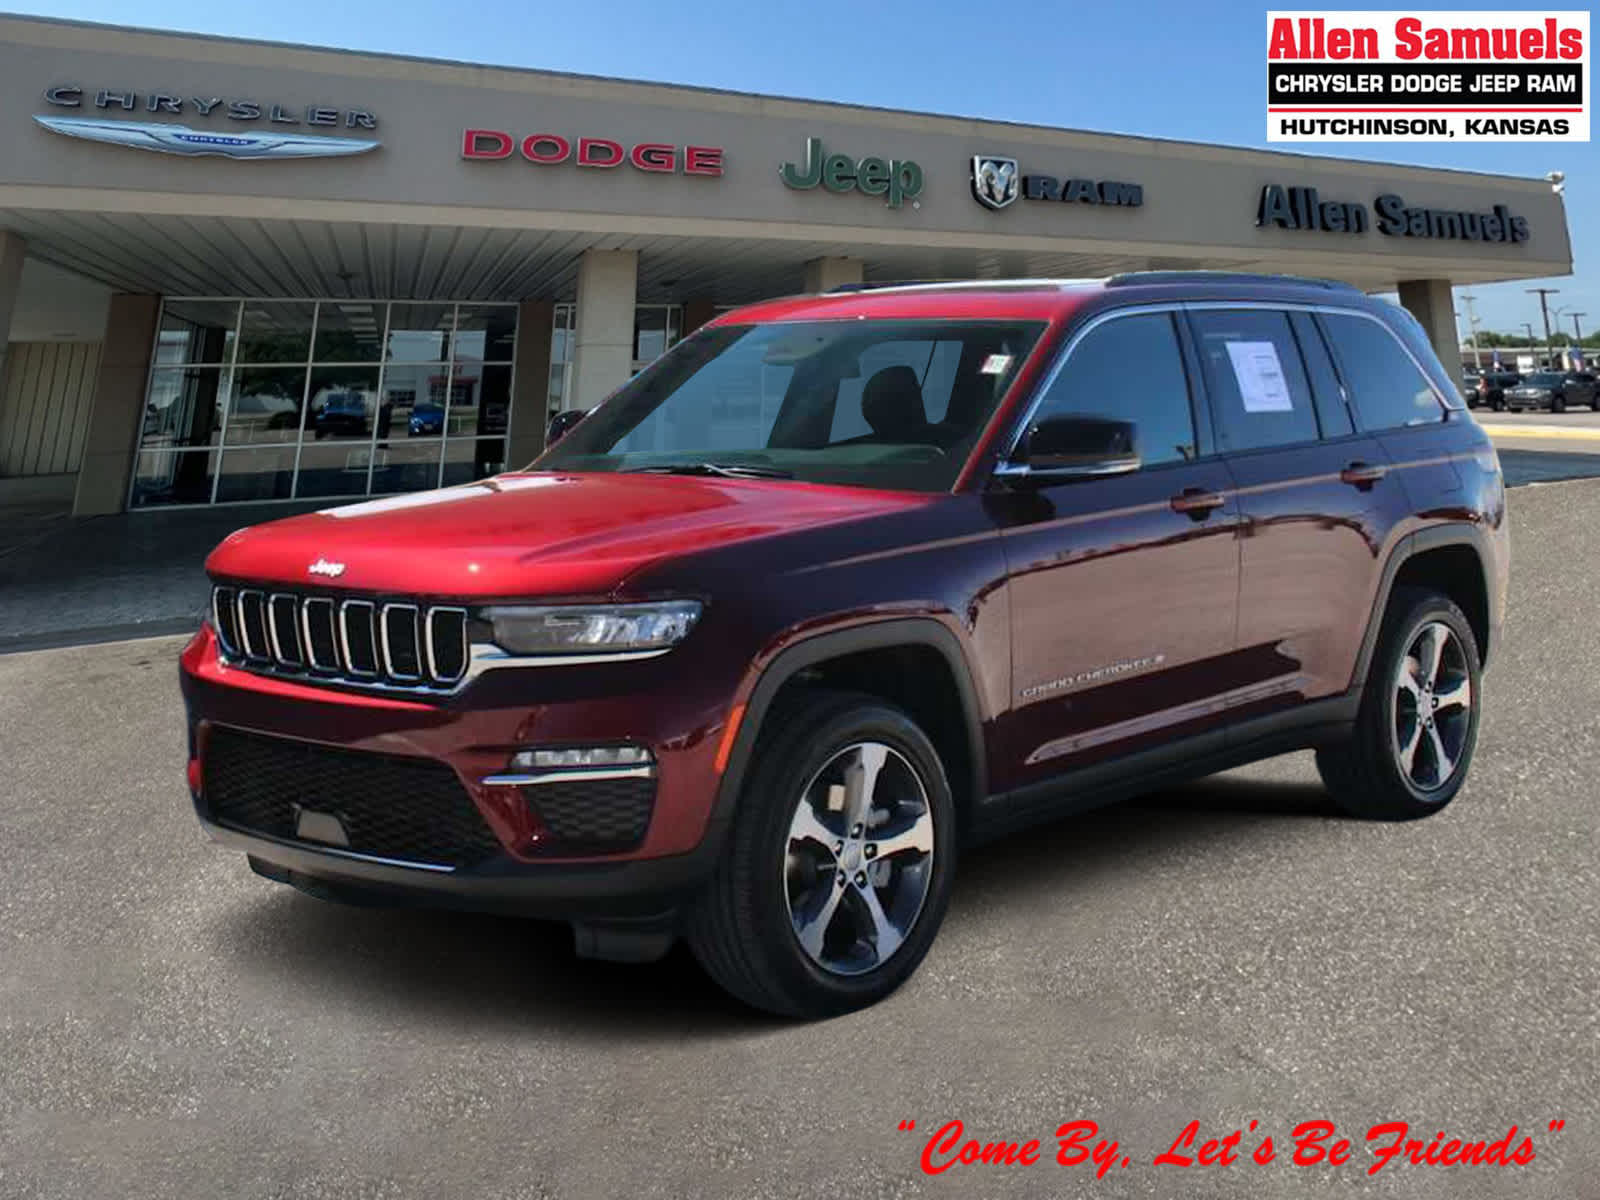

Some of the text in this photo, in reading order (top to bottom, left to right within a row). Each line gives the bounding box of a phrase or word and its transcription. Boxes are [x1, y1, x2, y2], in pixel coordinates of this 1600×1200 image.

[44, 86, 378, 130] CHRYSLER
[461, 128, 724, 177] DODGE
[779, 136, 924, 209] Jeep
[1022, 174, 1144, 207] RAM
[1256, 183, 1530, 244] Allen Samuels
[307, 558, 346, 578] Jeep
